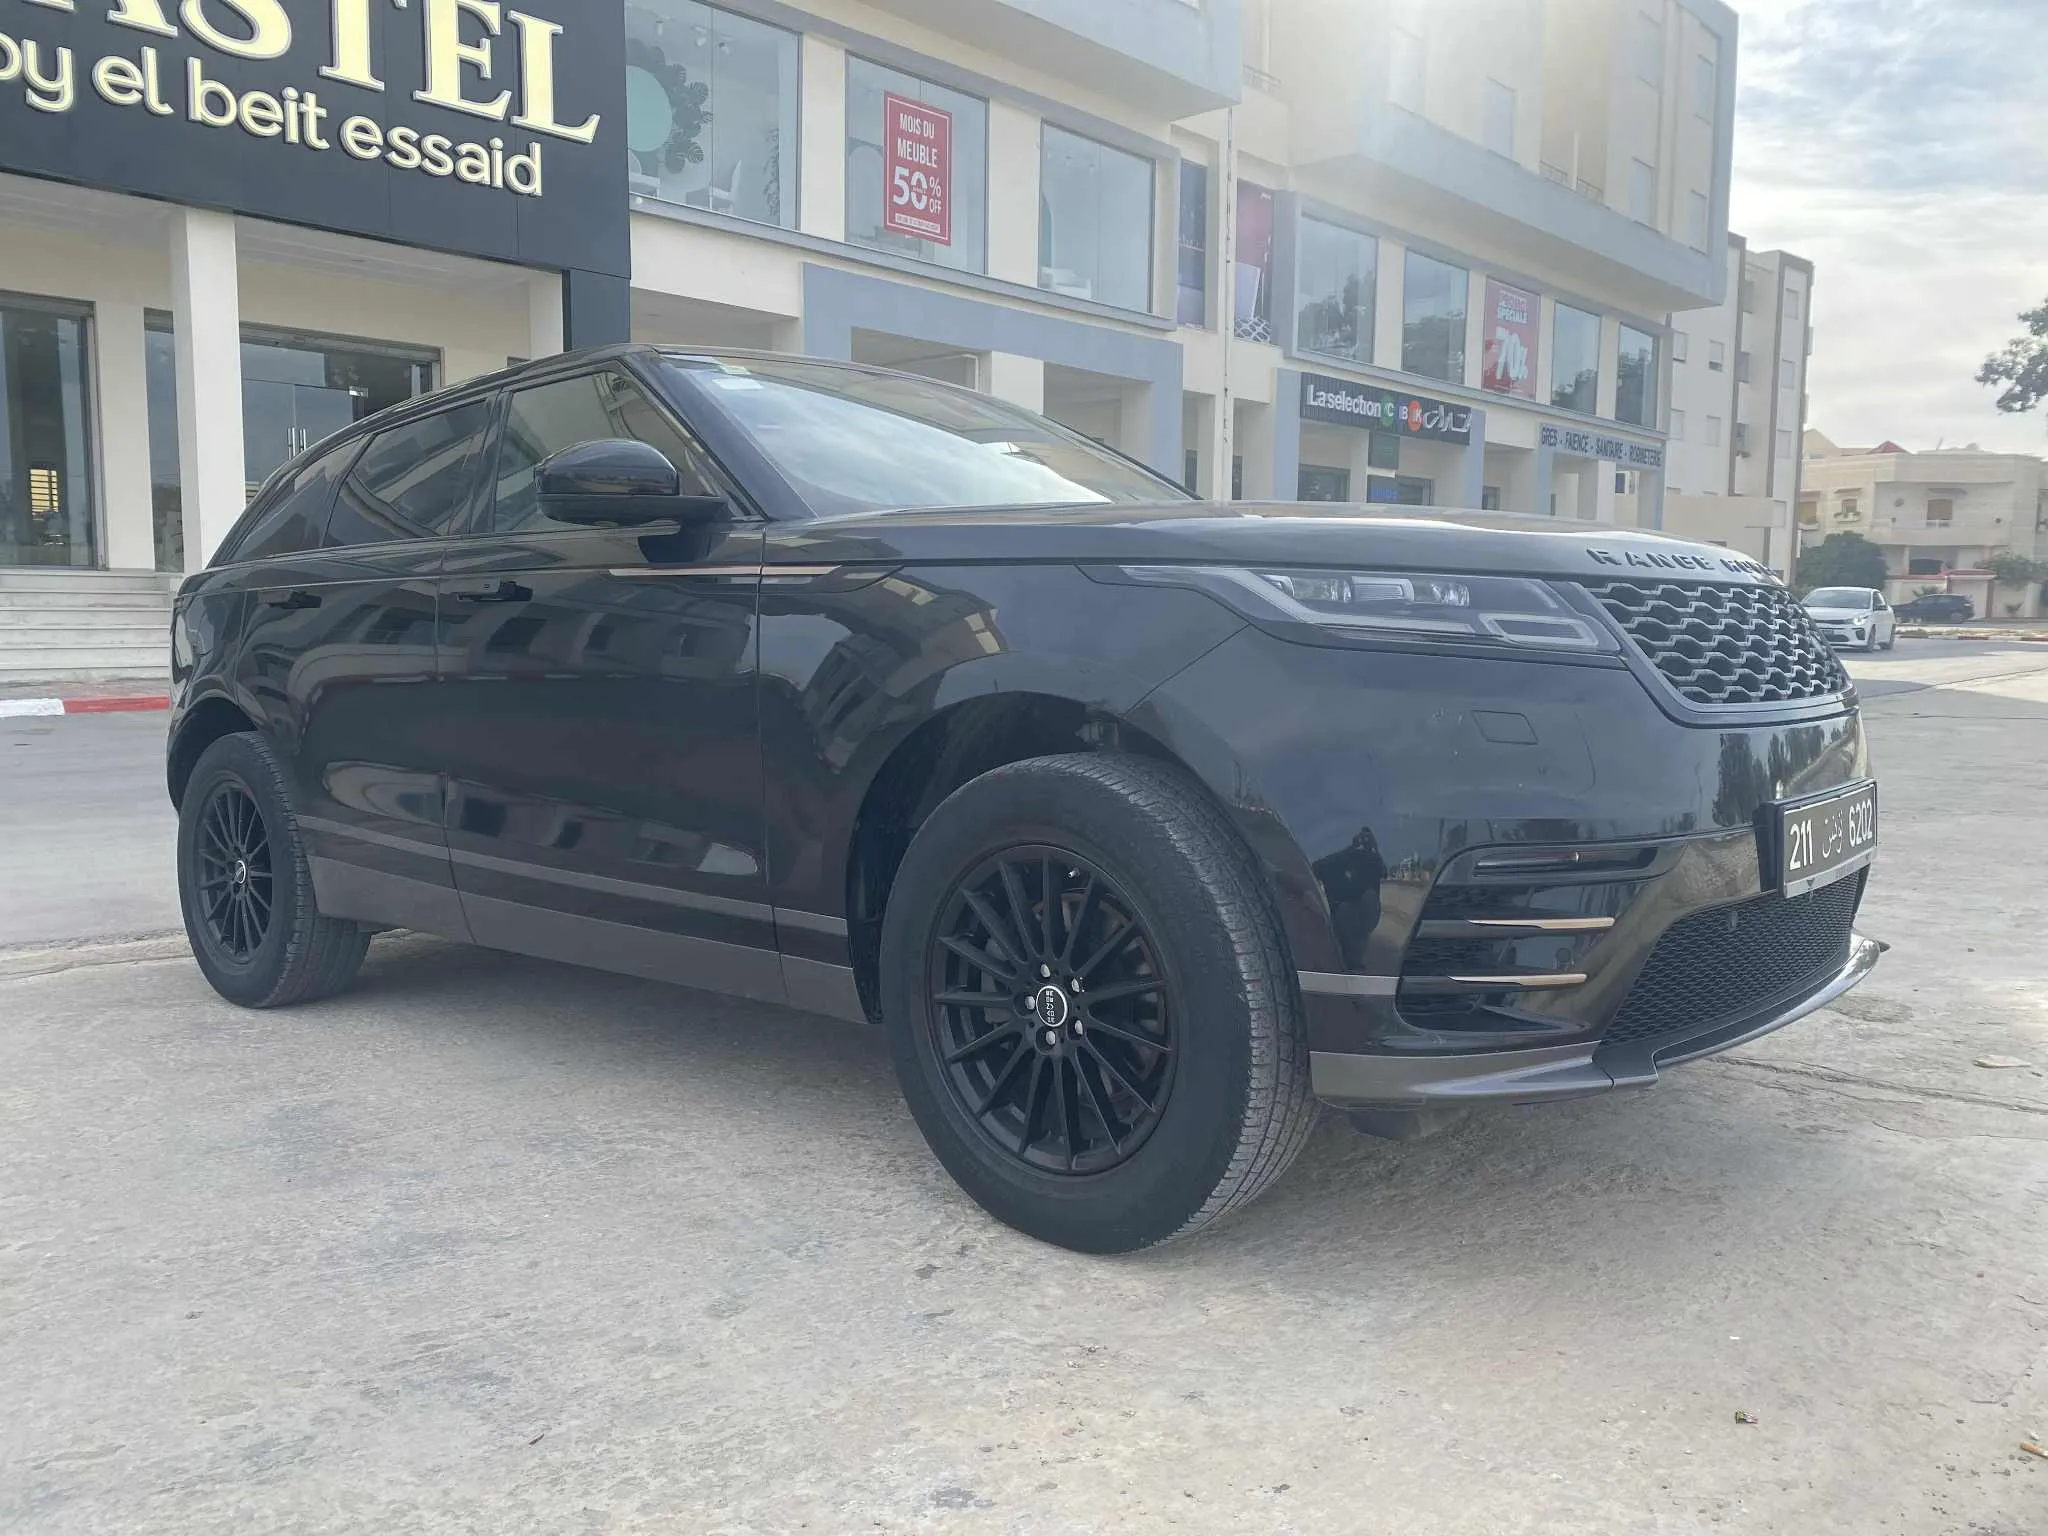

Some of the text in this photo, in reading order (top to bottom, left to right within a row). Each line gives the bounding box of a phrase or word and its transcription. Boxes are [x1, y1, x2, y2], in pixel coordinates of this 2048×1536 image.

[92, 46, 174, 115] el
[187, 56, 330, 150] beit
[338, 114, 543, 196] essaid
[899, 112, 935, 139] MOIS DU
[897, 137, 938, 168] MEUBLE
[930, 198, 942, 216] OFF
[1541, 426, 1558, 447] GRES
[1586, 548, 1715, 570] RANGE
[1789, 819, 1813, 870] 211
[1848, 798, 1873, 847] 6202
